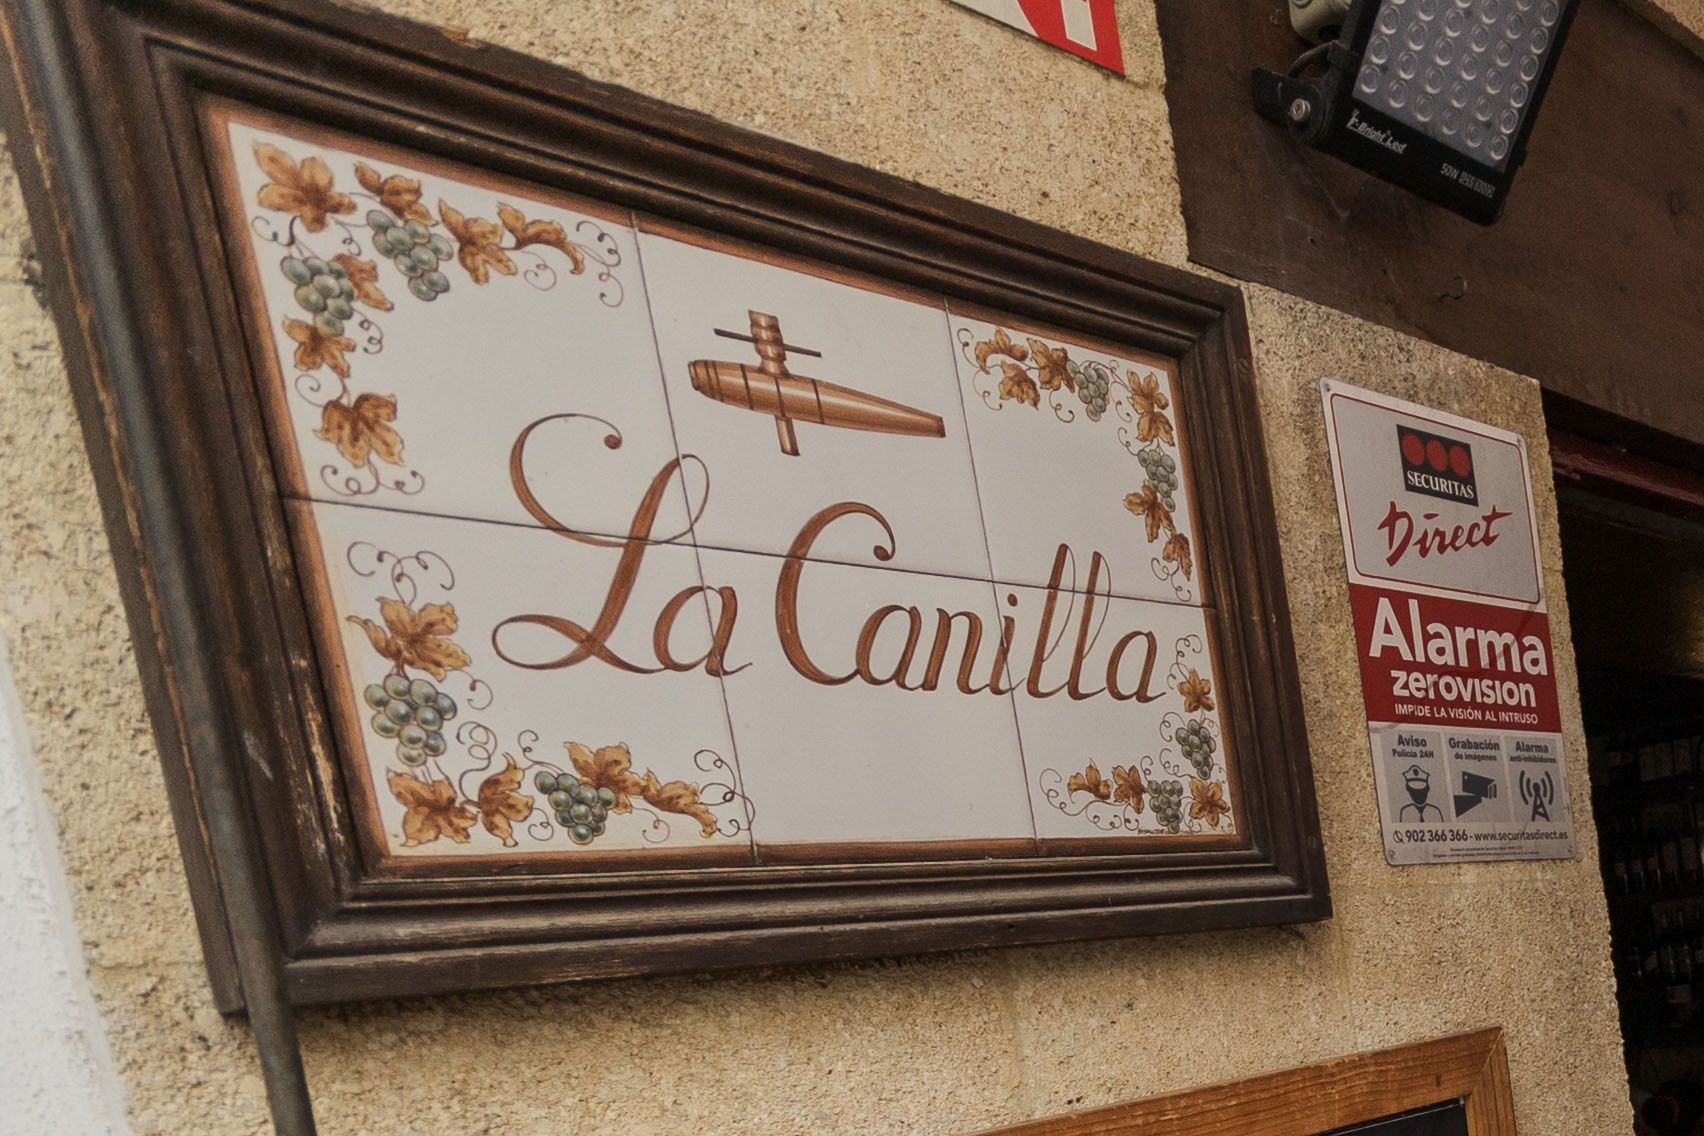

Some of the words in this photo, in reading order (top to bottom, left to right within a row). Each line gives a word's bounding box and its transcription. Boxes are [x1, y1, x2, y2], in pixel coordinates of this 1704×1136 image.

[1407, 469, 1474, 499] SECURITAS
[1377, 500, 1513, 567] Direct
[492, 413, 752, 676] La
[776, 501, 1166, 702] Canilla
[1368, 597, 1548, 675] Alarma
[1390, 669, 1536, 707] zerovision
[1395, 703, 1431, 717] IMPIDE
[1433, 706, 1447, 718] LA
[1449, 707, 1482, 720] VISIÓN
[1485, 711, 1497, 721] AL
[1500, 711, 1538, 724] INTRUSO
[1397, 734, 1427, 747] Aviso
[1448, 736, 1500, 751] Grabación
[1515, 741, 1549, 753] Alarma
[1454, 752, 1463, 760] de
[1405, 829, 1426, 842] 902
[1428, 829, 1447, 842] 366
[1449, 829, 1468, 842] 366
